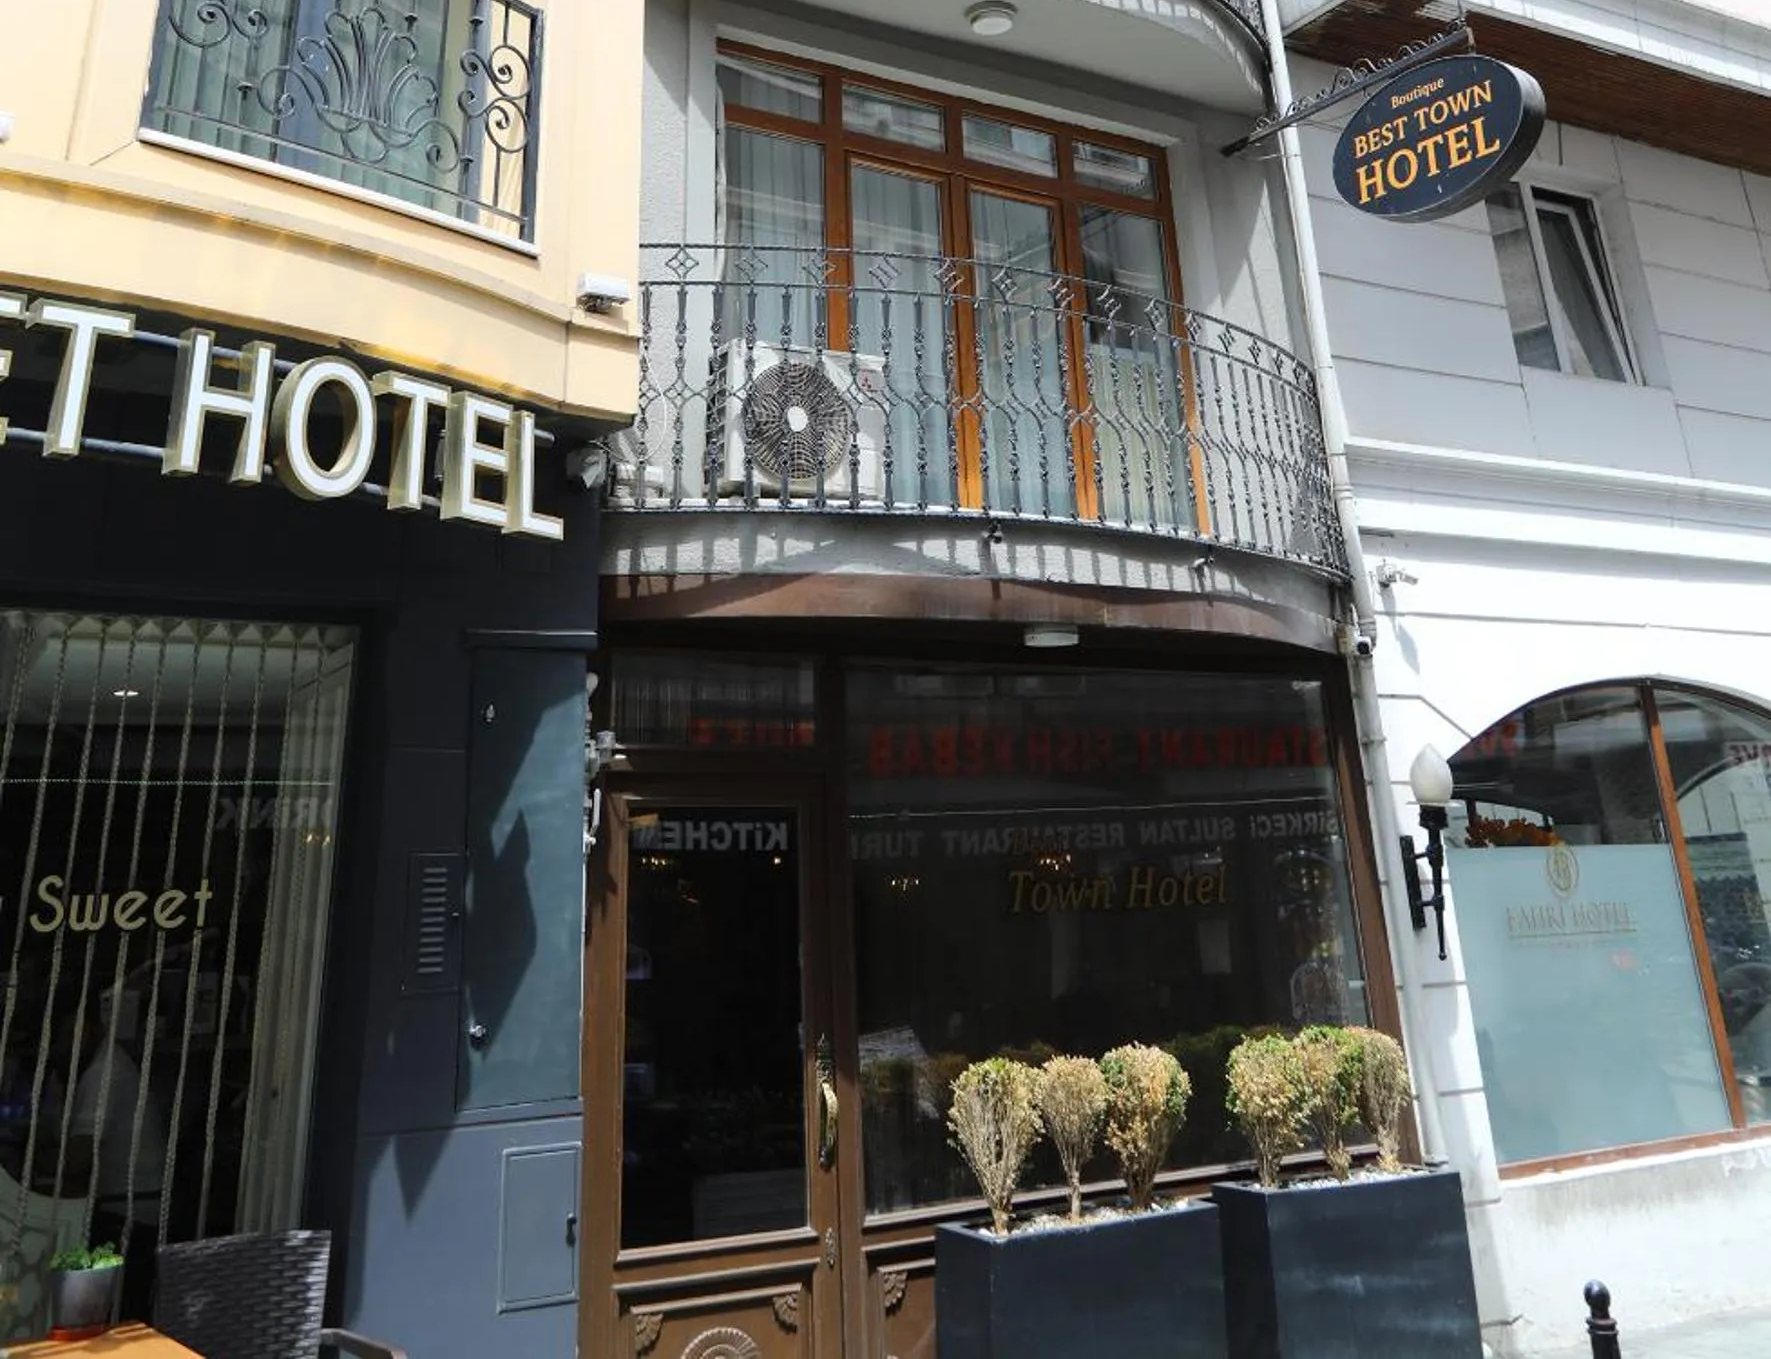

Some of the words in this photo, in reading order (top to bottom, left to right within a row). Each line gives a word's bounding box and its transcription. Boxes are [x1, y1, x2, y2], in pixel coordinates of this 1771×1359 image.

[1354, 116, 1407, 159] BEST
[1413, 79, 1493, 132] TOWN
[1391, 78, 1444, 109] Boutique
[1356, 116, 1500, 205] HOTEL
[162, 327, 564, 541] HOTEL
[29, 875, 213, 933] Sweet
[1009, 869, 1117, 914] Town
[1122, 862, 1229, 909] Hotel
